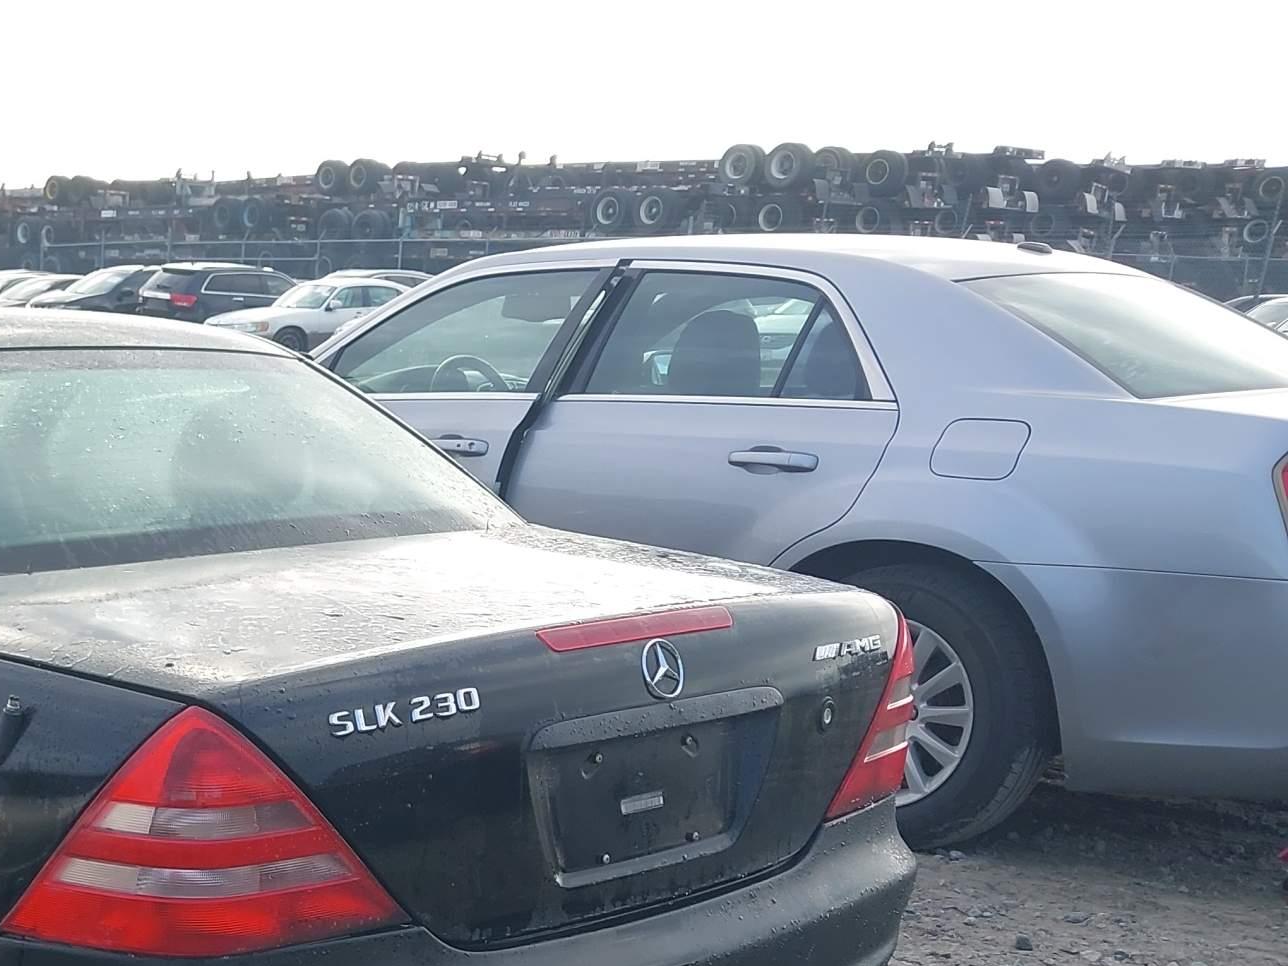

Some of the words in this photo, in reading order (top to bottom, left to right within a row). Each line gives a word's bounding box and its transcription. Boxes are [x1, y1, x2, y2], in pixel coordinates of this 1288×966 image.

[840, 634, 881, 656] AMG
[328, 701, 402, 736] SLK
[409, 687, 481, 722] 230
